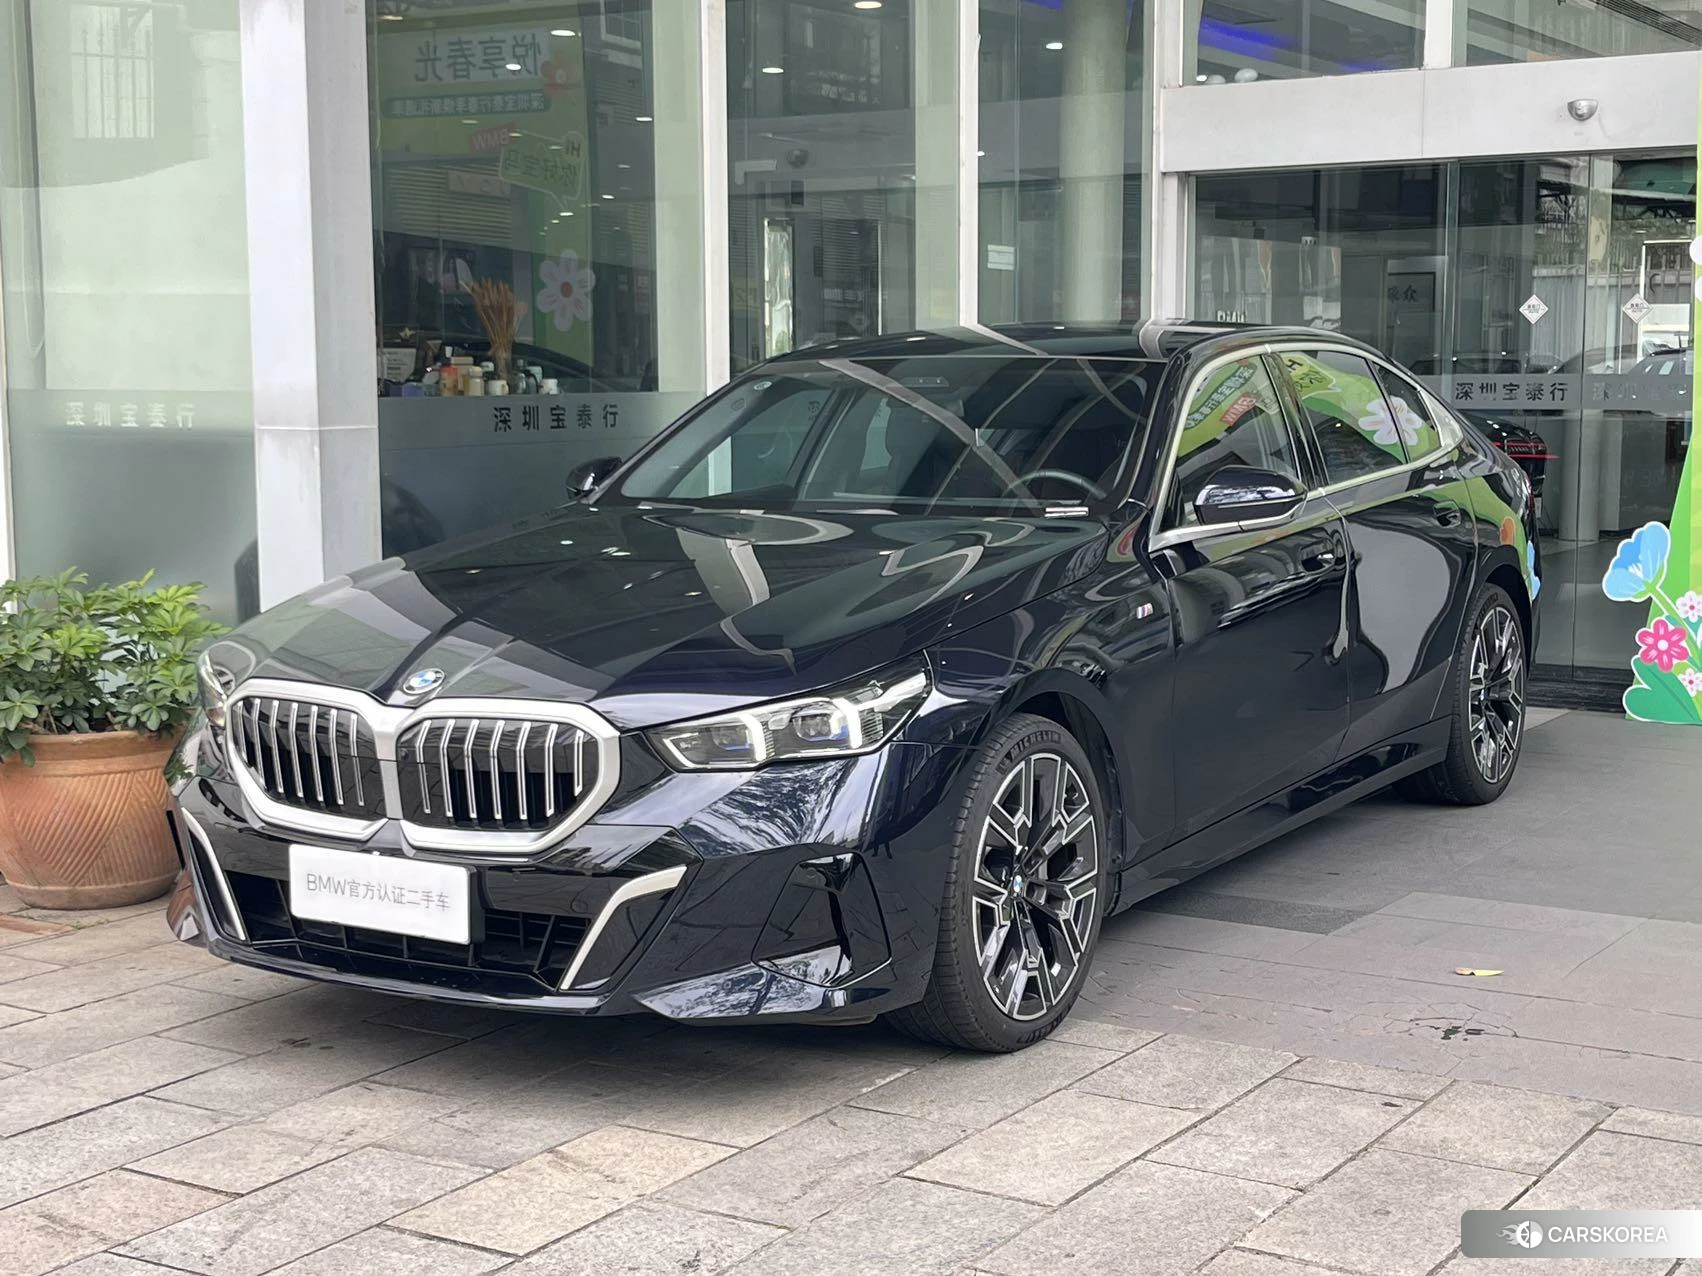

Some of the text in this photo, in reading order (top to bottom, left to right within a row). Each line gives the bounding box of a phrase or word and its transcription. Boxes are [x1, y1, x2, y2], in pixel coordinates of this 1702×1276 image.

[1455, 382, 1569, 402] 深圳宝泰行
[493, 404, 619, 433] 深圳宝泰行
[306, 873, 452, 912] BMW官方认证二手车
